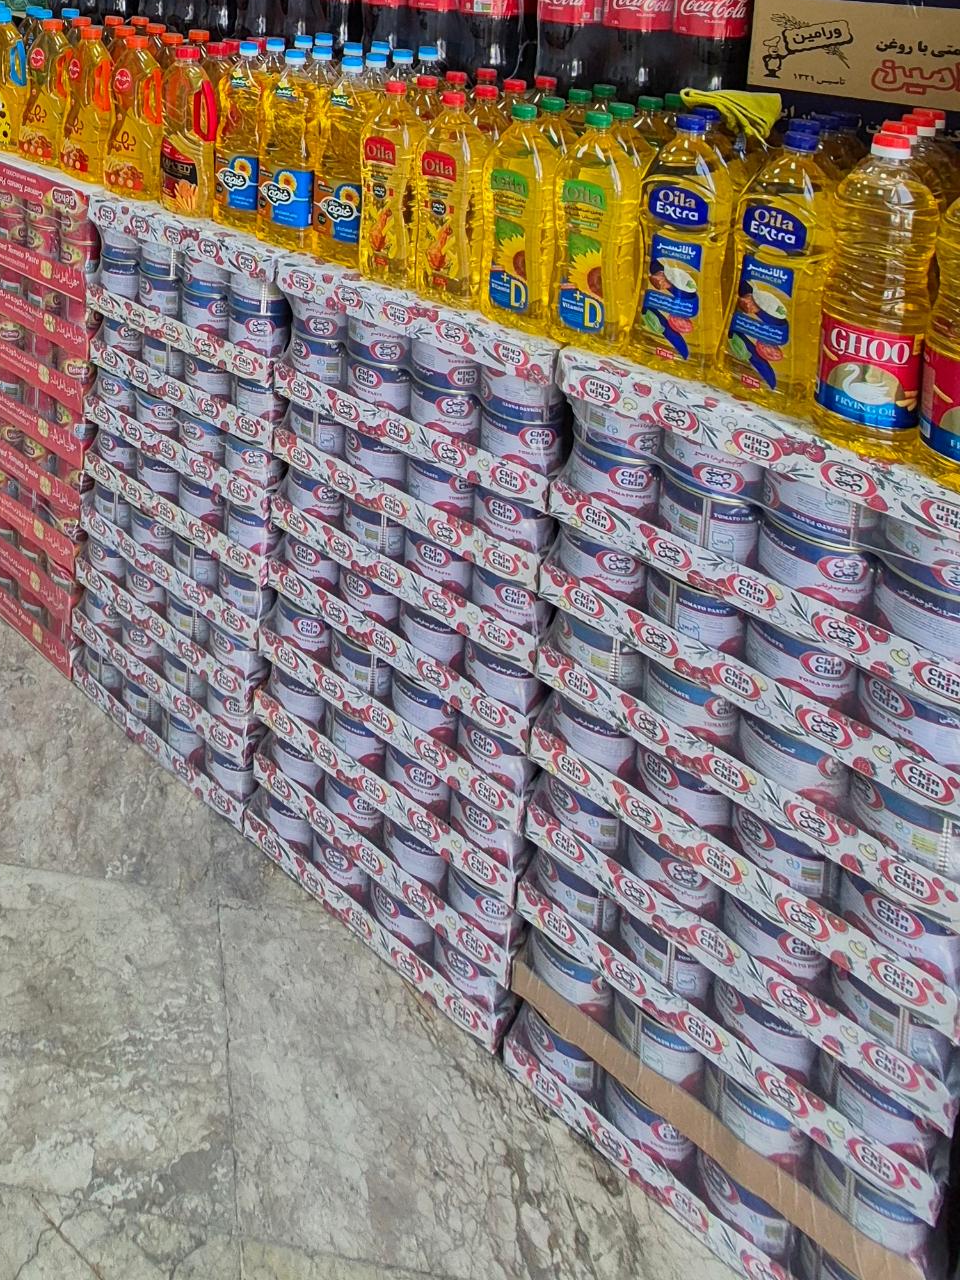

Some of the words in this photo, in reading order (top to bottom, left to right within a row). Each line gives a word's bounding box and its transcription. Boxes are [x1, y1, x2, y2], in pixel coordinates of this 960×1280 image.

[792, 26, 843, 45] ورامین
[875, 37, 913, 55] روغن
[367, 144, 393, 160] Oila
[423, 157, 454, 176] Oila
[658, 189, 696, 209] Oila
[656, 202, 699, 221] Extra
[754, 209, 795, 232] Oila
[750, 221, 796, 245] Extra
[661, 249, 691, 260] BALANCER
[750, 270, 783, 284] BALANCER
[562, 301, 584, 313] Vitamin
[831, 327, 910, 365] GHOO
[835, 394, 876, 414] FRYING
[879, 407, 897, 418] OIL
[744, 434, 770, 448] Chin
[743, 443, 770, 457] Chin
[620, 479, 644, 488] Chin
[621, 470, 645, 480] Chin
[585, 516, 607, 529] Chin
[586, 508, 607, 522] Chin
[738, 588, 763, 603] Chin
[739, 579, 764, 595] Chin
[574, 590, 595, 604] Chin
[574, 597, 594, 613] Chin
[678, 598, 706, 613] TOMATO
[568, 671, 588, 687] Chin
[724, 676, 748, 693] Chin
[726, 668, 749, 684] Chin
[799, 676, 830, 689] TOMATO
[928, 668, 960, 687] Chin
[568, 679, 588, 695] Chin
[927, 678, 959, 697] Chin
[713, 768, 737, 786] Chin
[714, 760, 737, 777] Chin
[909, 767, 939, 788] Chin
[908, 776, 939, 797] Chin
[895, 866, 925, 887] Chin
[894, 875, 924, 897] Chin
[885, 966, 914, 987] Chin
[883, 975, 913, 997] Chin
[876, 1050, 905, 1071] Chin
[875, 1059, 905, 1082] Chin
